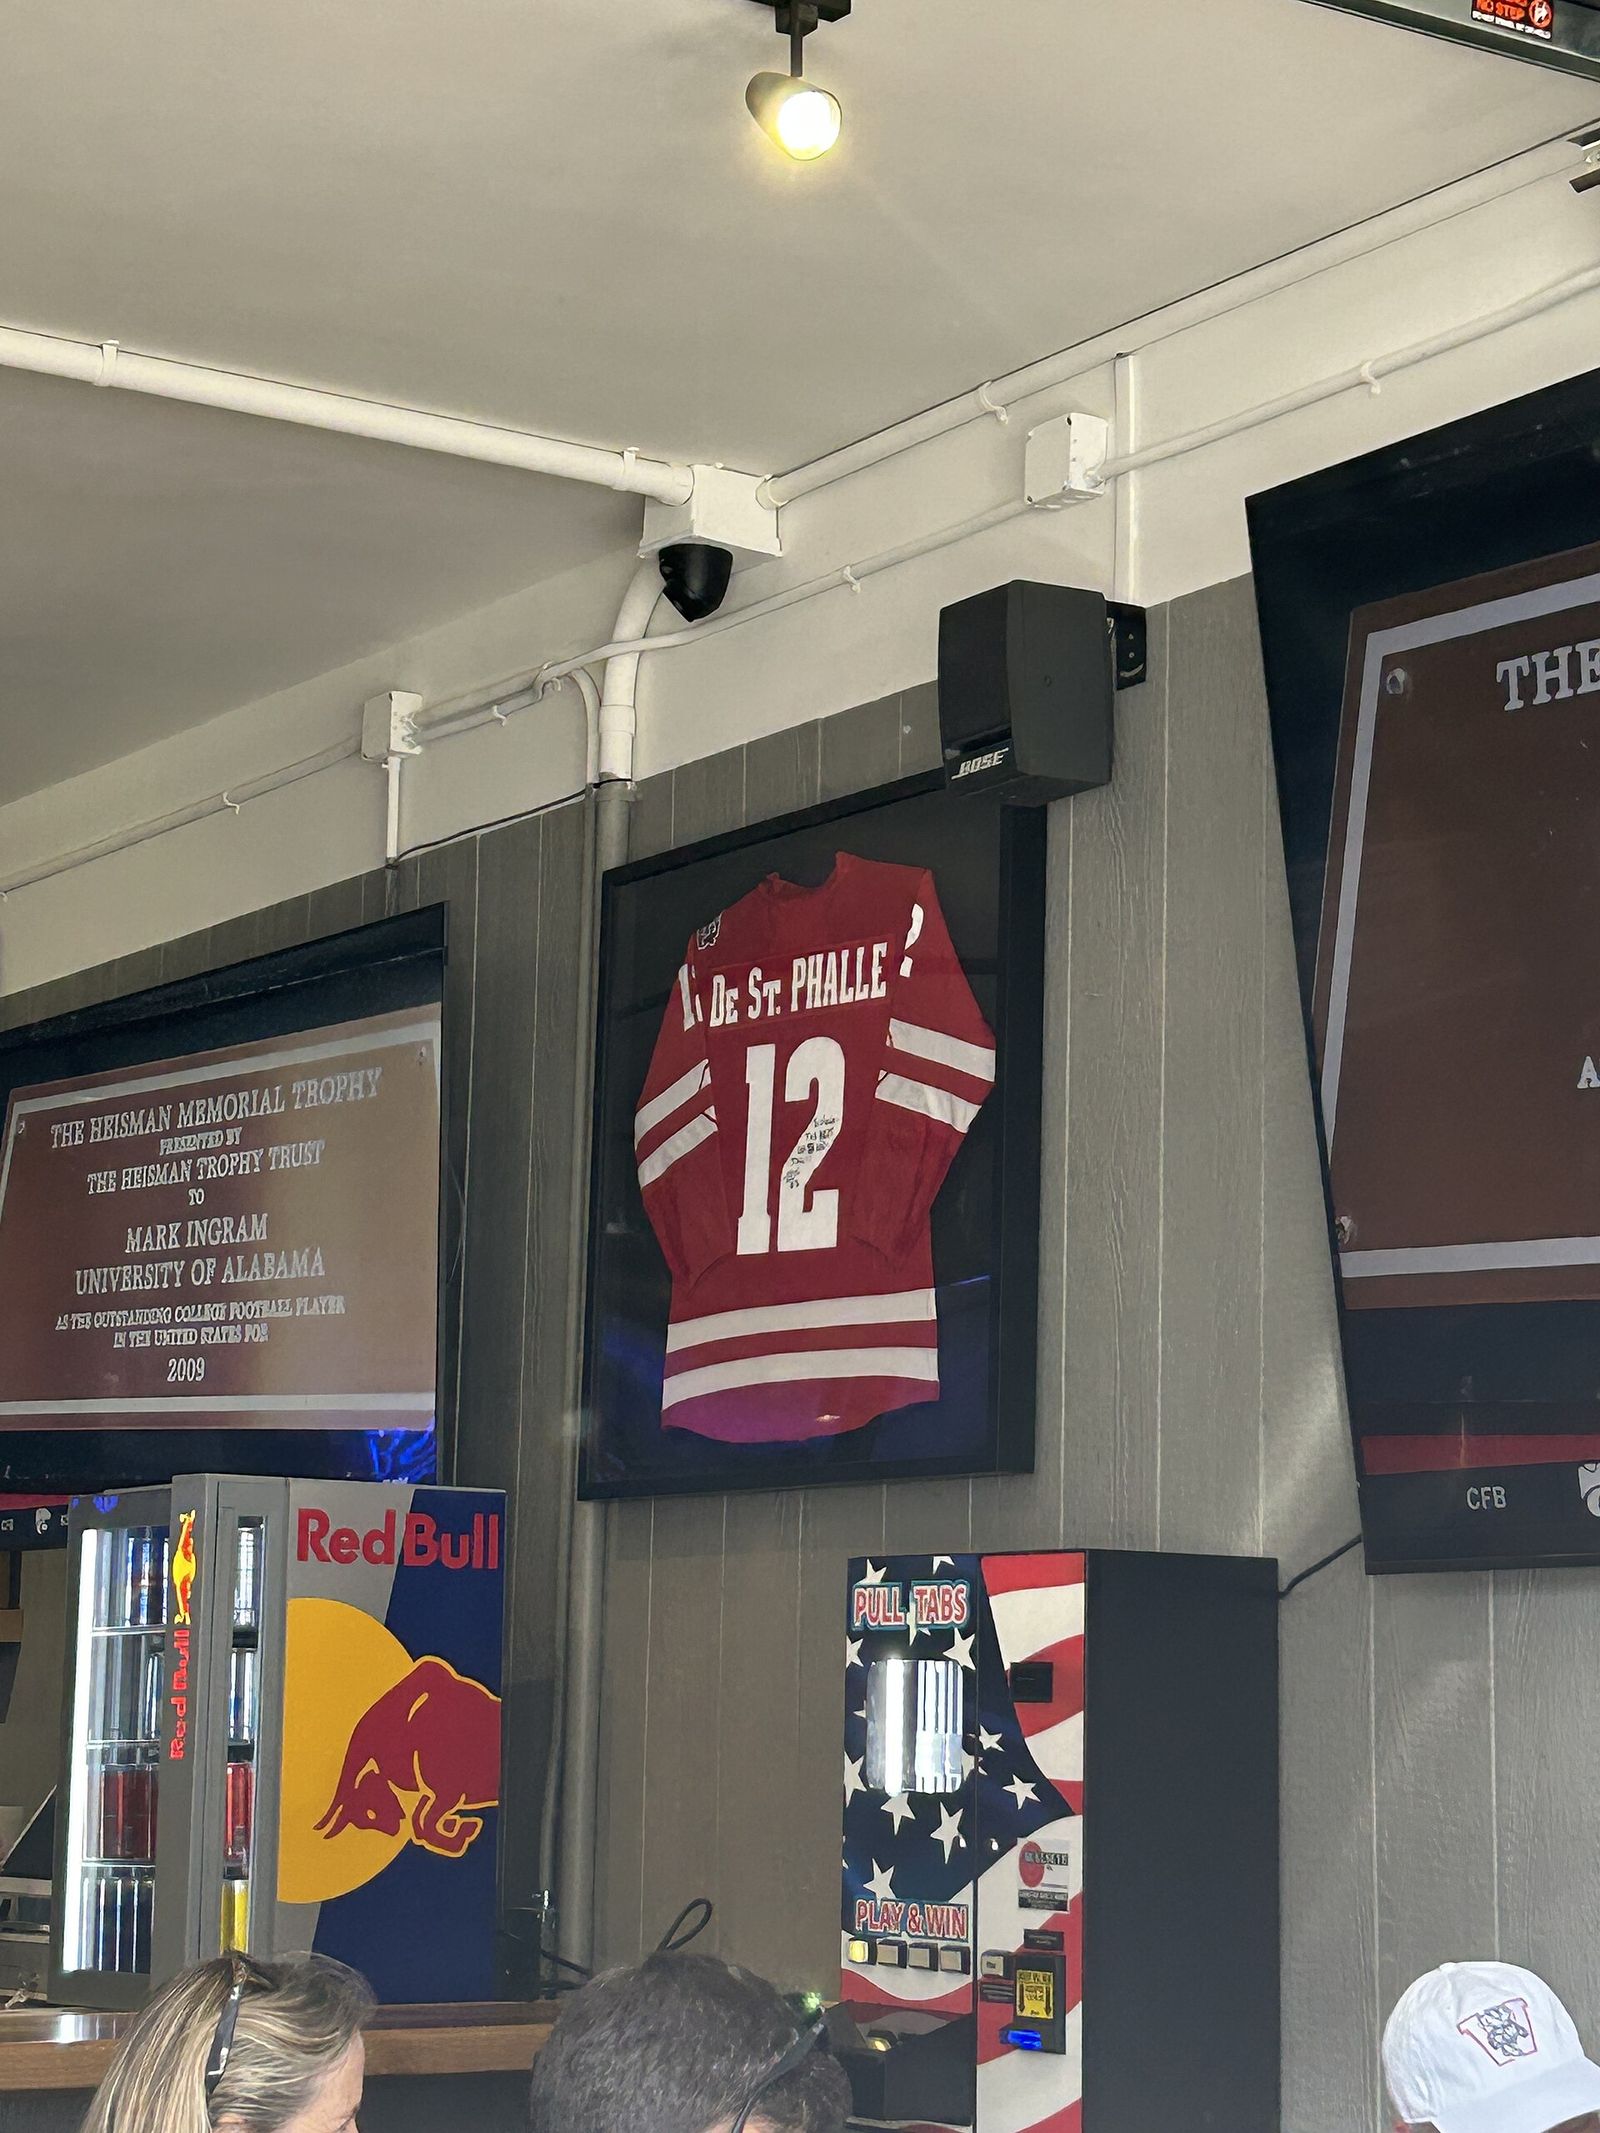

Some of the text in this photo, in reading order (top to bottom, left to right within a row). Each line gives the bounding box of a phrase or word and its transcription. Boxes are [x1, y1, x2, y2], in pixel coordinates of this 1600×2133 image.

[1496, 638, 1600, 712] THE
[952, 747, 1009, 780] BOSE
[790, 942, 888, 1014] PHALLE
[1576, 1055, 1600, 1089] A
[50, 1066, 382, 1149] THE HEISMAN MEMORIAL TROPHY
[226, 1126, 242, 1145] BY
[736, 1036, 845, 1256] 12
[87, 1140, 326, 1195] THE HEISMAN TROPHY TRUST
[188, 1188, 205, 1206] TO
[124, 1212, 268, 1254] MARK INGRAM
[75, 1246, 326, 1296] UNIVERSITY OF ALABAMA
[69, 1312, 92, 1330] THE
[93, 1305, 172, 1329] OUTSTANDING
[228, 1298, 293, 1321] FOOTBALL
[295, 1295, 346, 1317] PLAYER
[167, 1356, 206, 1383] 2009
[1466, 1485, 1507, 1510] CFB
[297, 1508, 499, 1569] Red Bull
[854, 1583, 967, 1627] PULL TABS
[169, 1695, 187, 1760] Red
[856, 1900, 968, 1939] PLAY & WIN
